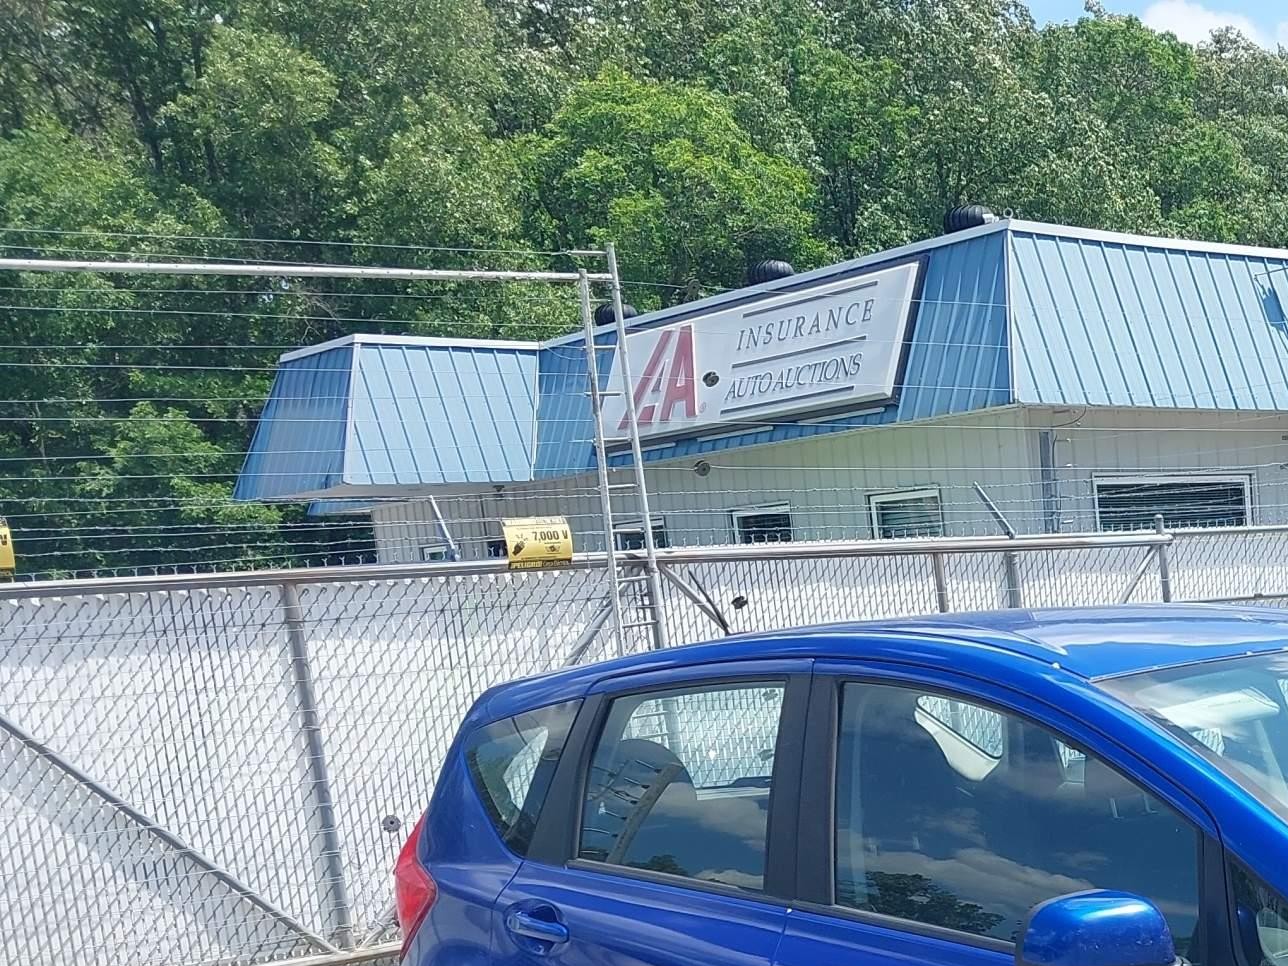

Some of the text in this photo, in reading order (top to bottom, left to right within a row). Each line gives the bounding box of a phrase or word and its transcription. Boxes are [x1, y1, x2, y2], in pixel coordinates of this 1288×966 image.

[736, 299, 874, 351] INSURANCE
[724, 352, 863, 401] AUTO AUCTIONS
[532, 529, 569, 543] 7,000 V
